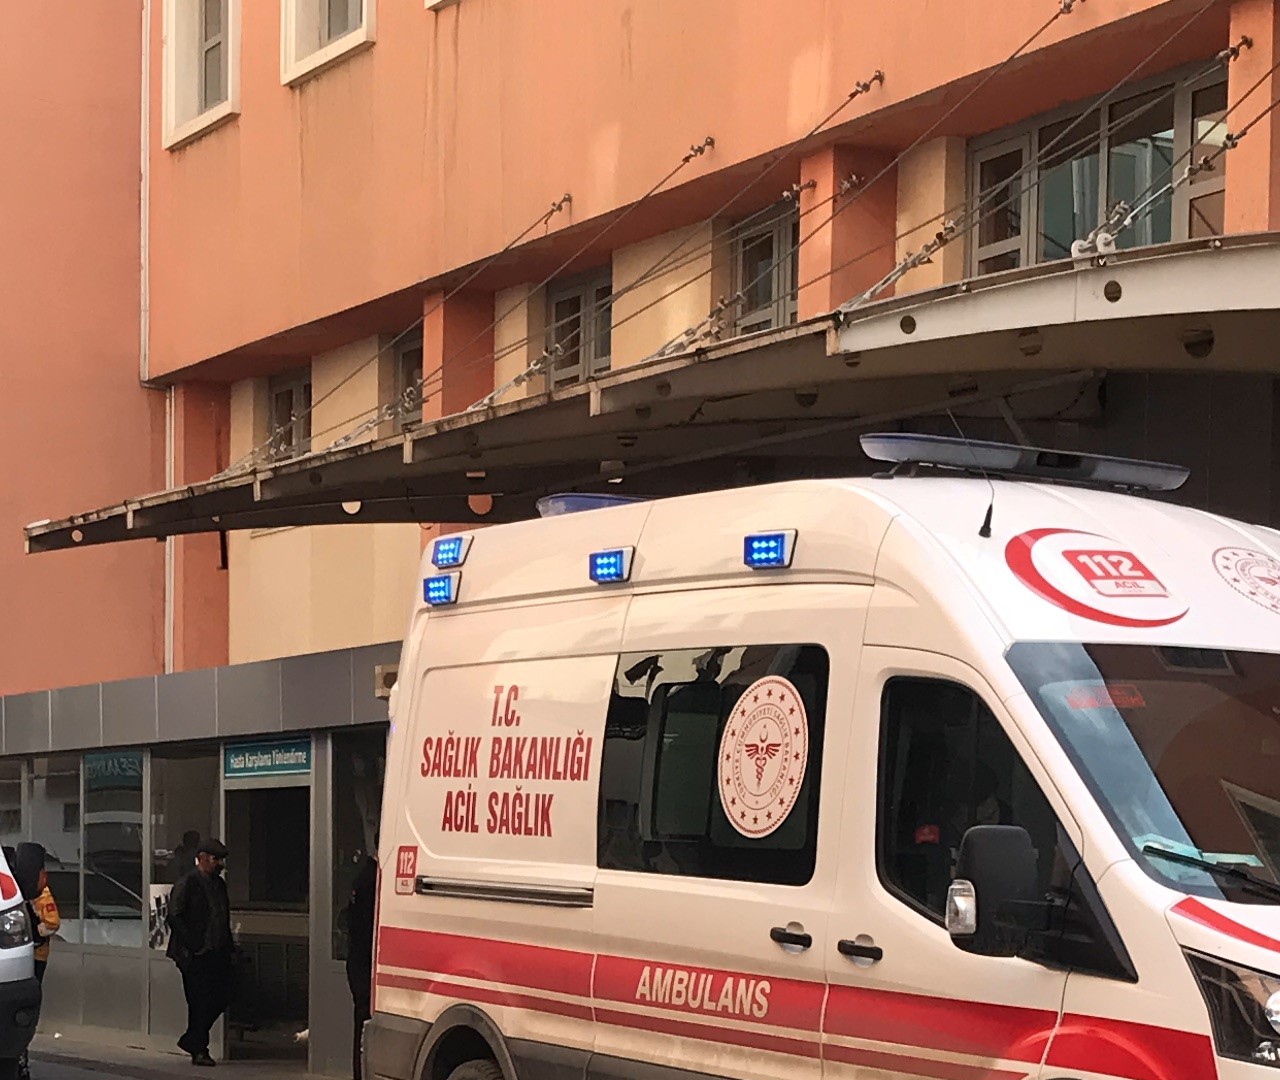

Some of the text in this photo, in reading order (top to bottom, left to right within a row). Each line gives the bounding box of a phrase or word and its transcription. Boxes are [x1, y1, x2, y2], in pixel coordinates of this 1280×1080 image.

[1076, 554, 1145, 577] 112
[491, 684, 521, 727] T.C.
[420, 729, 593, 781] SAĞLIK BAKANLIĞI
[442, 783, 554, 837] ACİL SAĞLIK
[400, 851, 415, 875] 112
[635, 966, 771, 1019] AMBULANS
